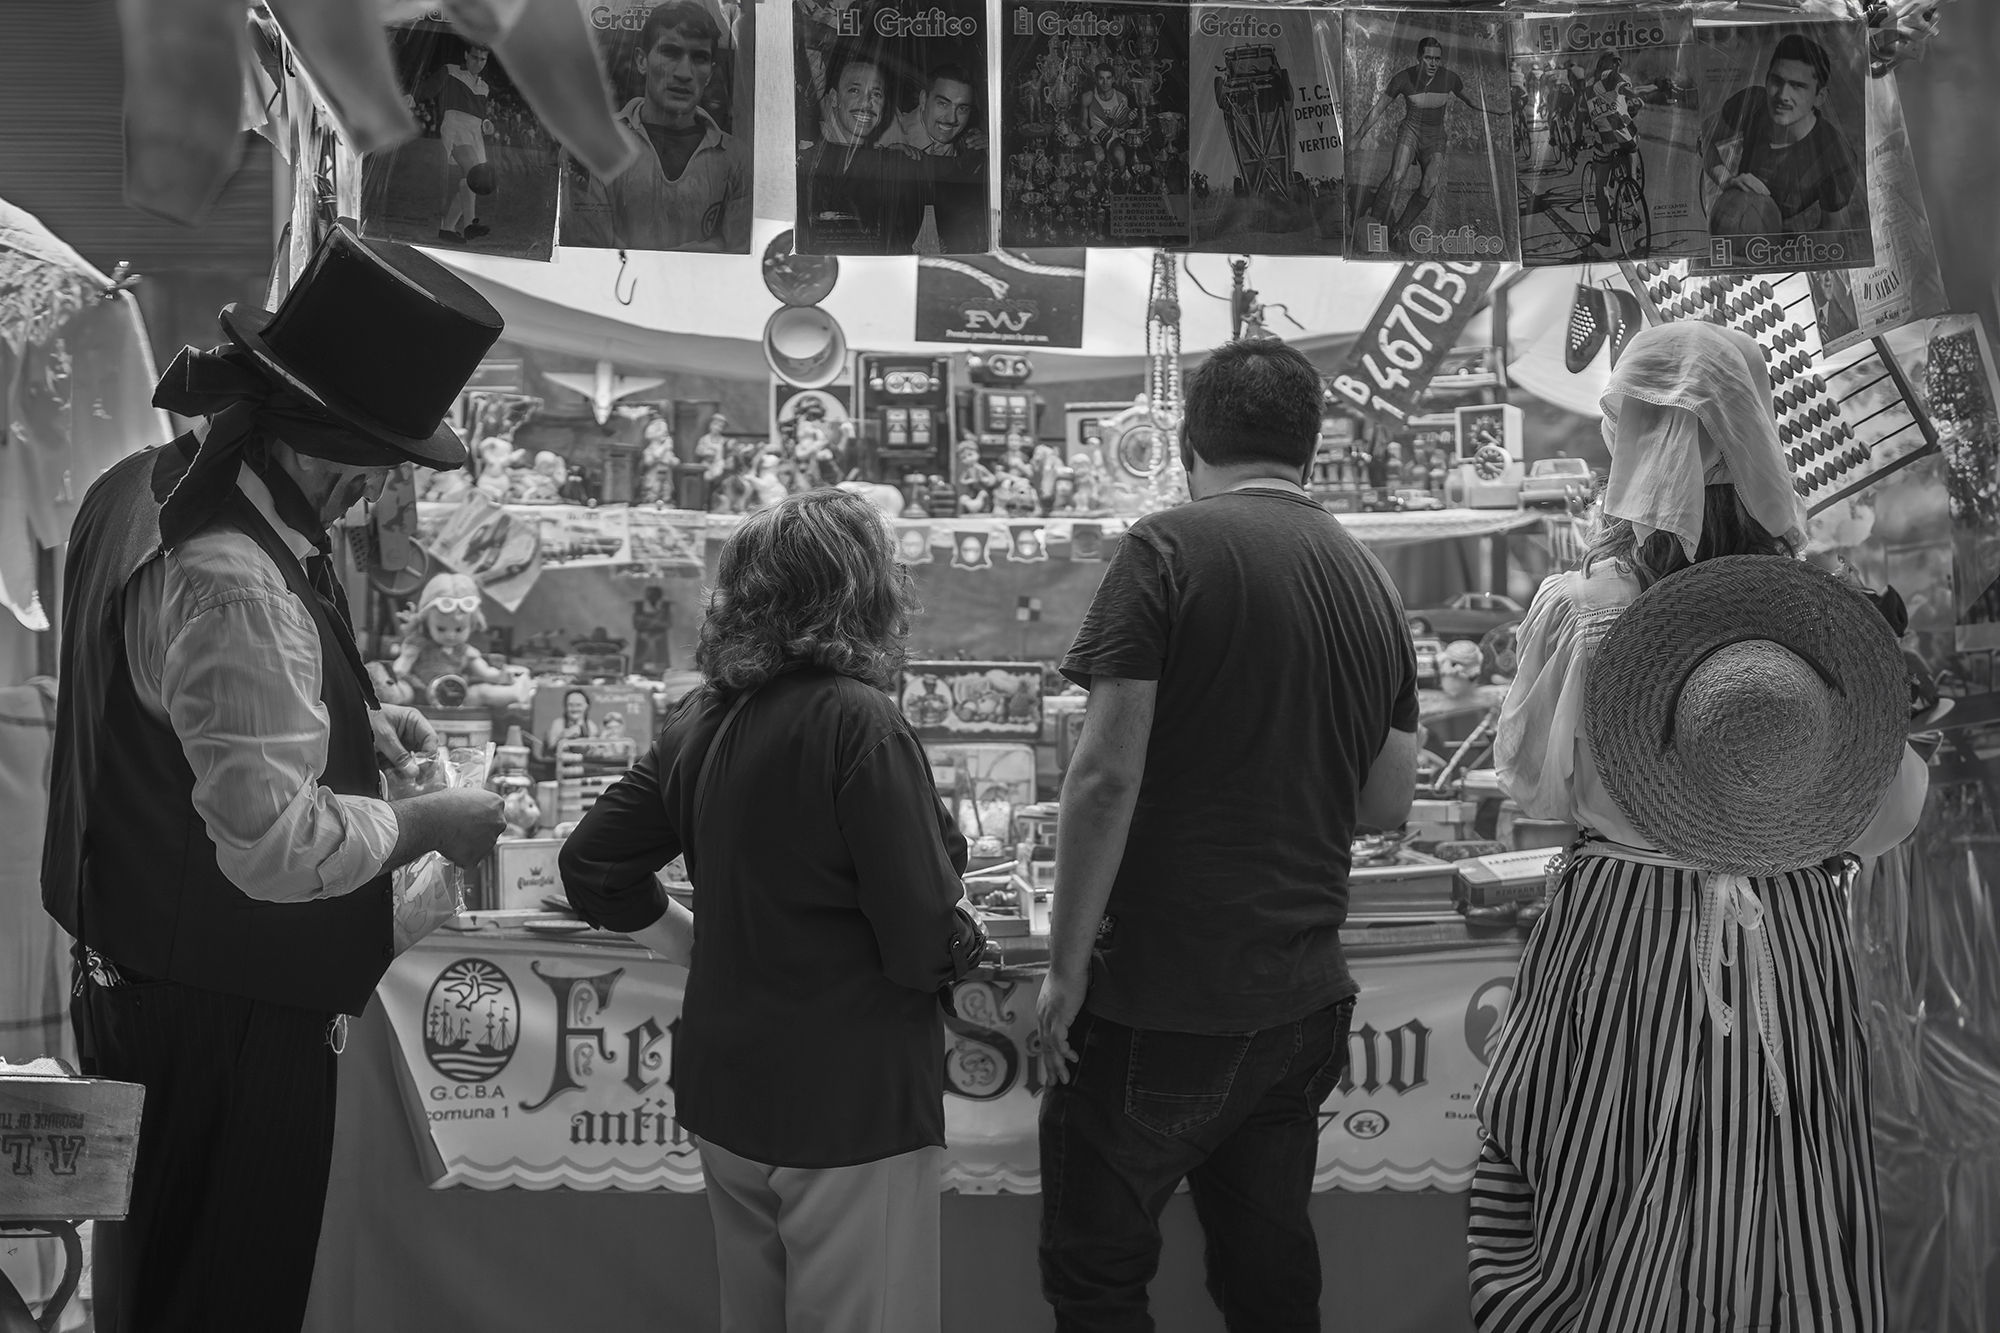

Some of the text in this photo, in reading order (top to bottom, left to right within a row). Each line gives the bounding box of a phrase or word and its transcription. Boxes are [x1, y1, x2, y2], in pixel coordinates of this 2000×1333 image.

[837, 7, 977, 37] El Gráfico
[1014, 8, 1123, 36] El Gráfico
[1199, 13, 1282, 38] Gráfico
[1538, 20, 1664, 53] El Gráfico
[1316, 121, 1324, 134] Y
[1298, 135, 1342, 153] VERTIG
[1367, 222, 1504, 254] El Gráfico
[1710, 234, 1845, 267] El Gráfico
[502, 1105, 509, 1119] 1
